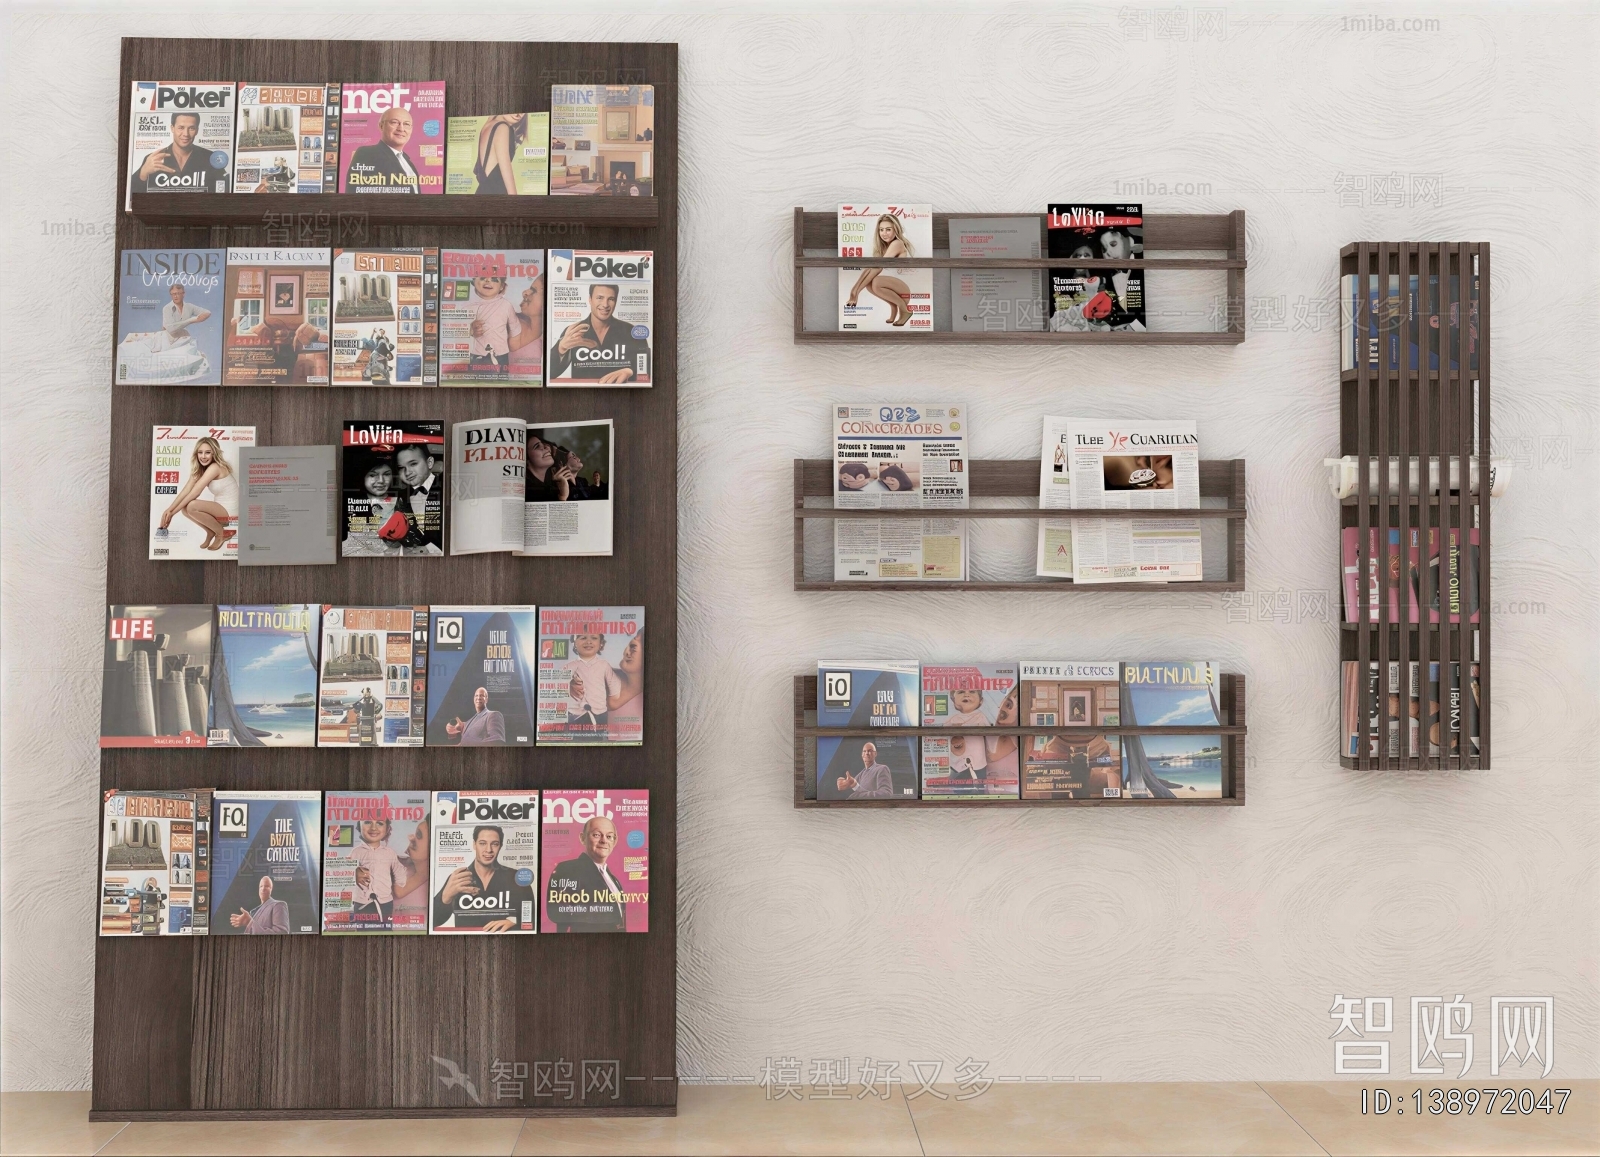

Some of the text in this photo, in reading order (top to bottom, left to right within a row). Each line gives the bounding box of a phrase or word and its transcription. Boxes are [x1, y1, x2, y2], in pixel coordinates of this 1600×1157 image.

[576, 344, 626, 361] Cool!
[111, 619, 153, 639] LIFE
[458, 798, 535, 820] Poker
[543, 790, 614, 824] net
[459, 891, 510, 910] Cool!
